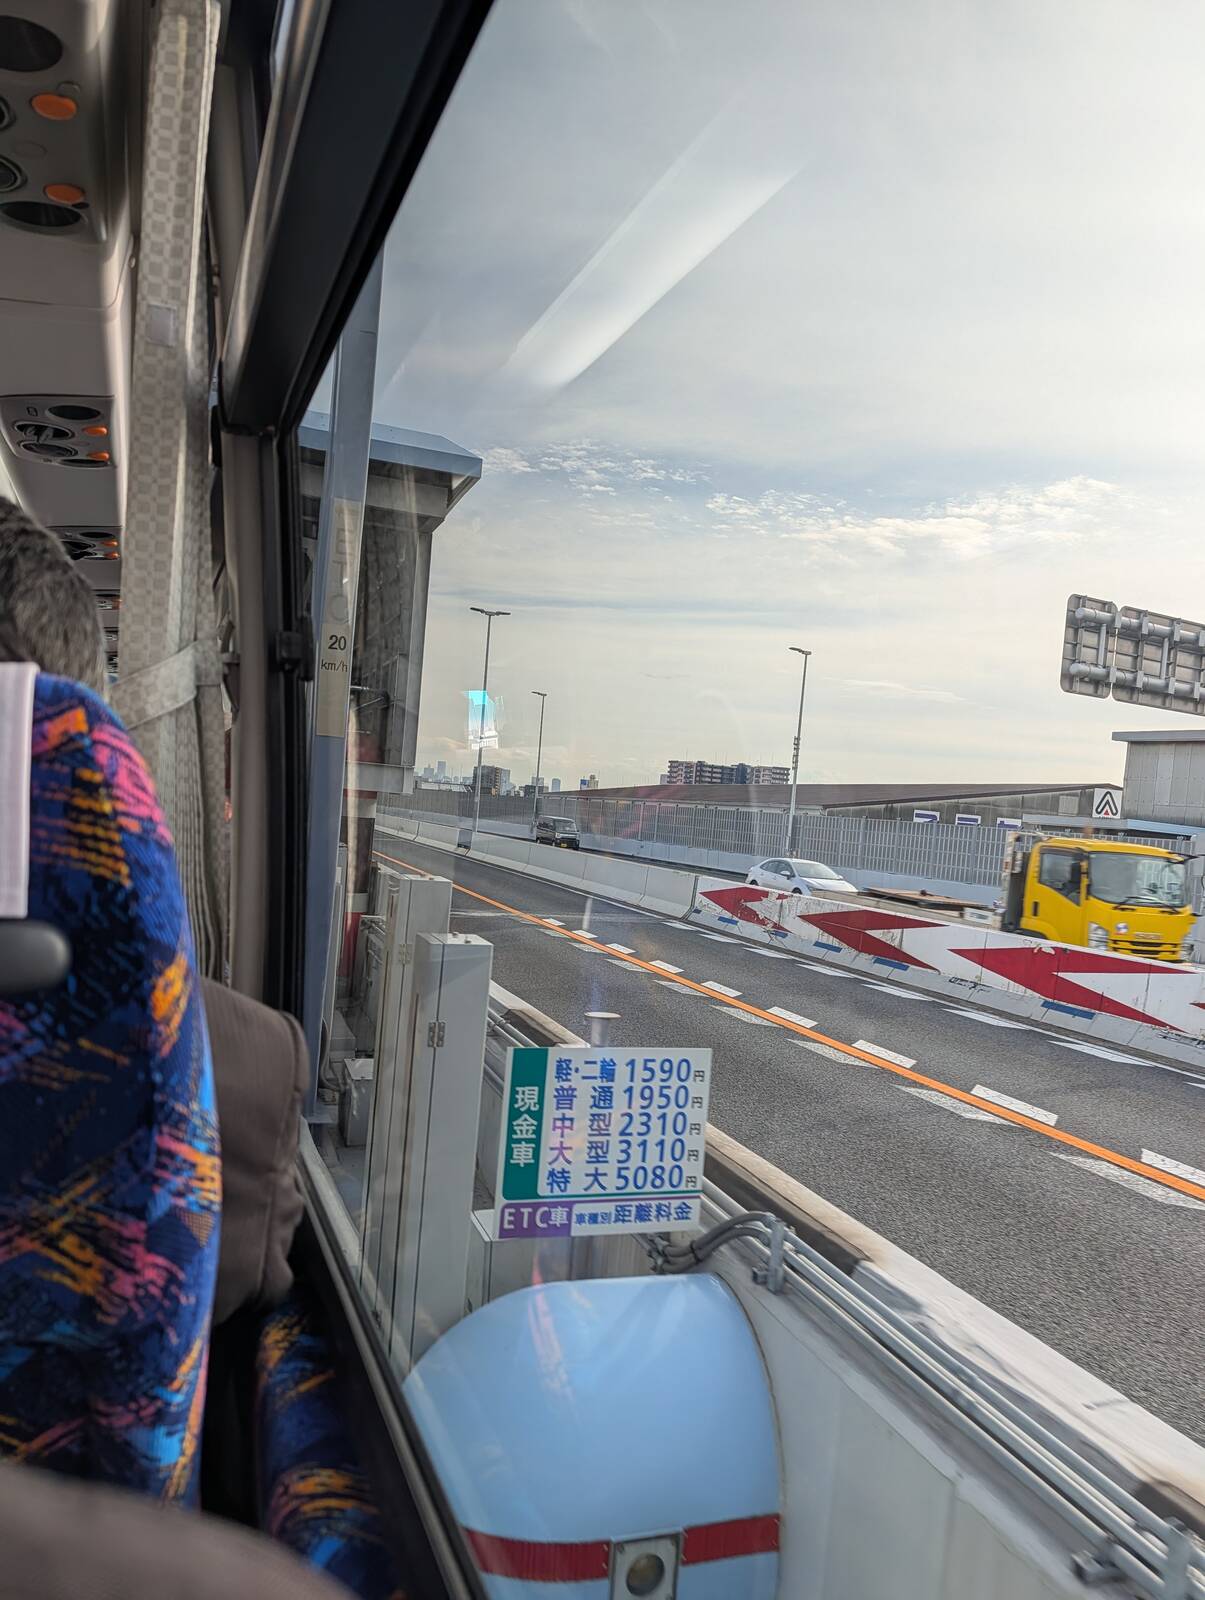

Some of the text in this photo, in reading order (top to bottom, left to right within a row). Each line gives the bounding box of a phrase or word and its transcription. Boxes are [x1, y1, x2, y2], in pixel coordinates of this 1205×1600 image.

[328, 634, 347, 650] 20
[321, 659, 348, 673] km/h
[509, 1086, 539, 1167] 現金車
[503, 1205, 570, 1229] ETC車
